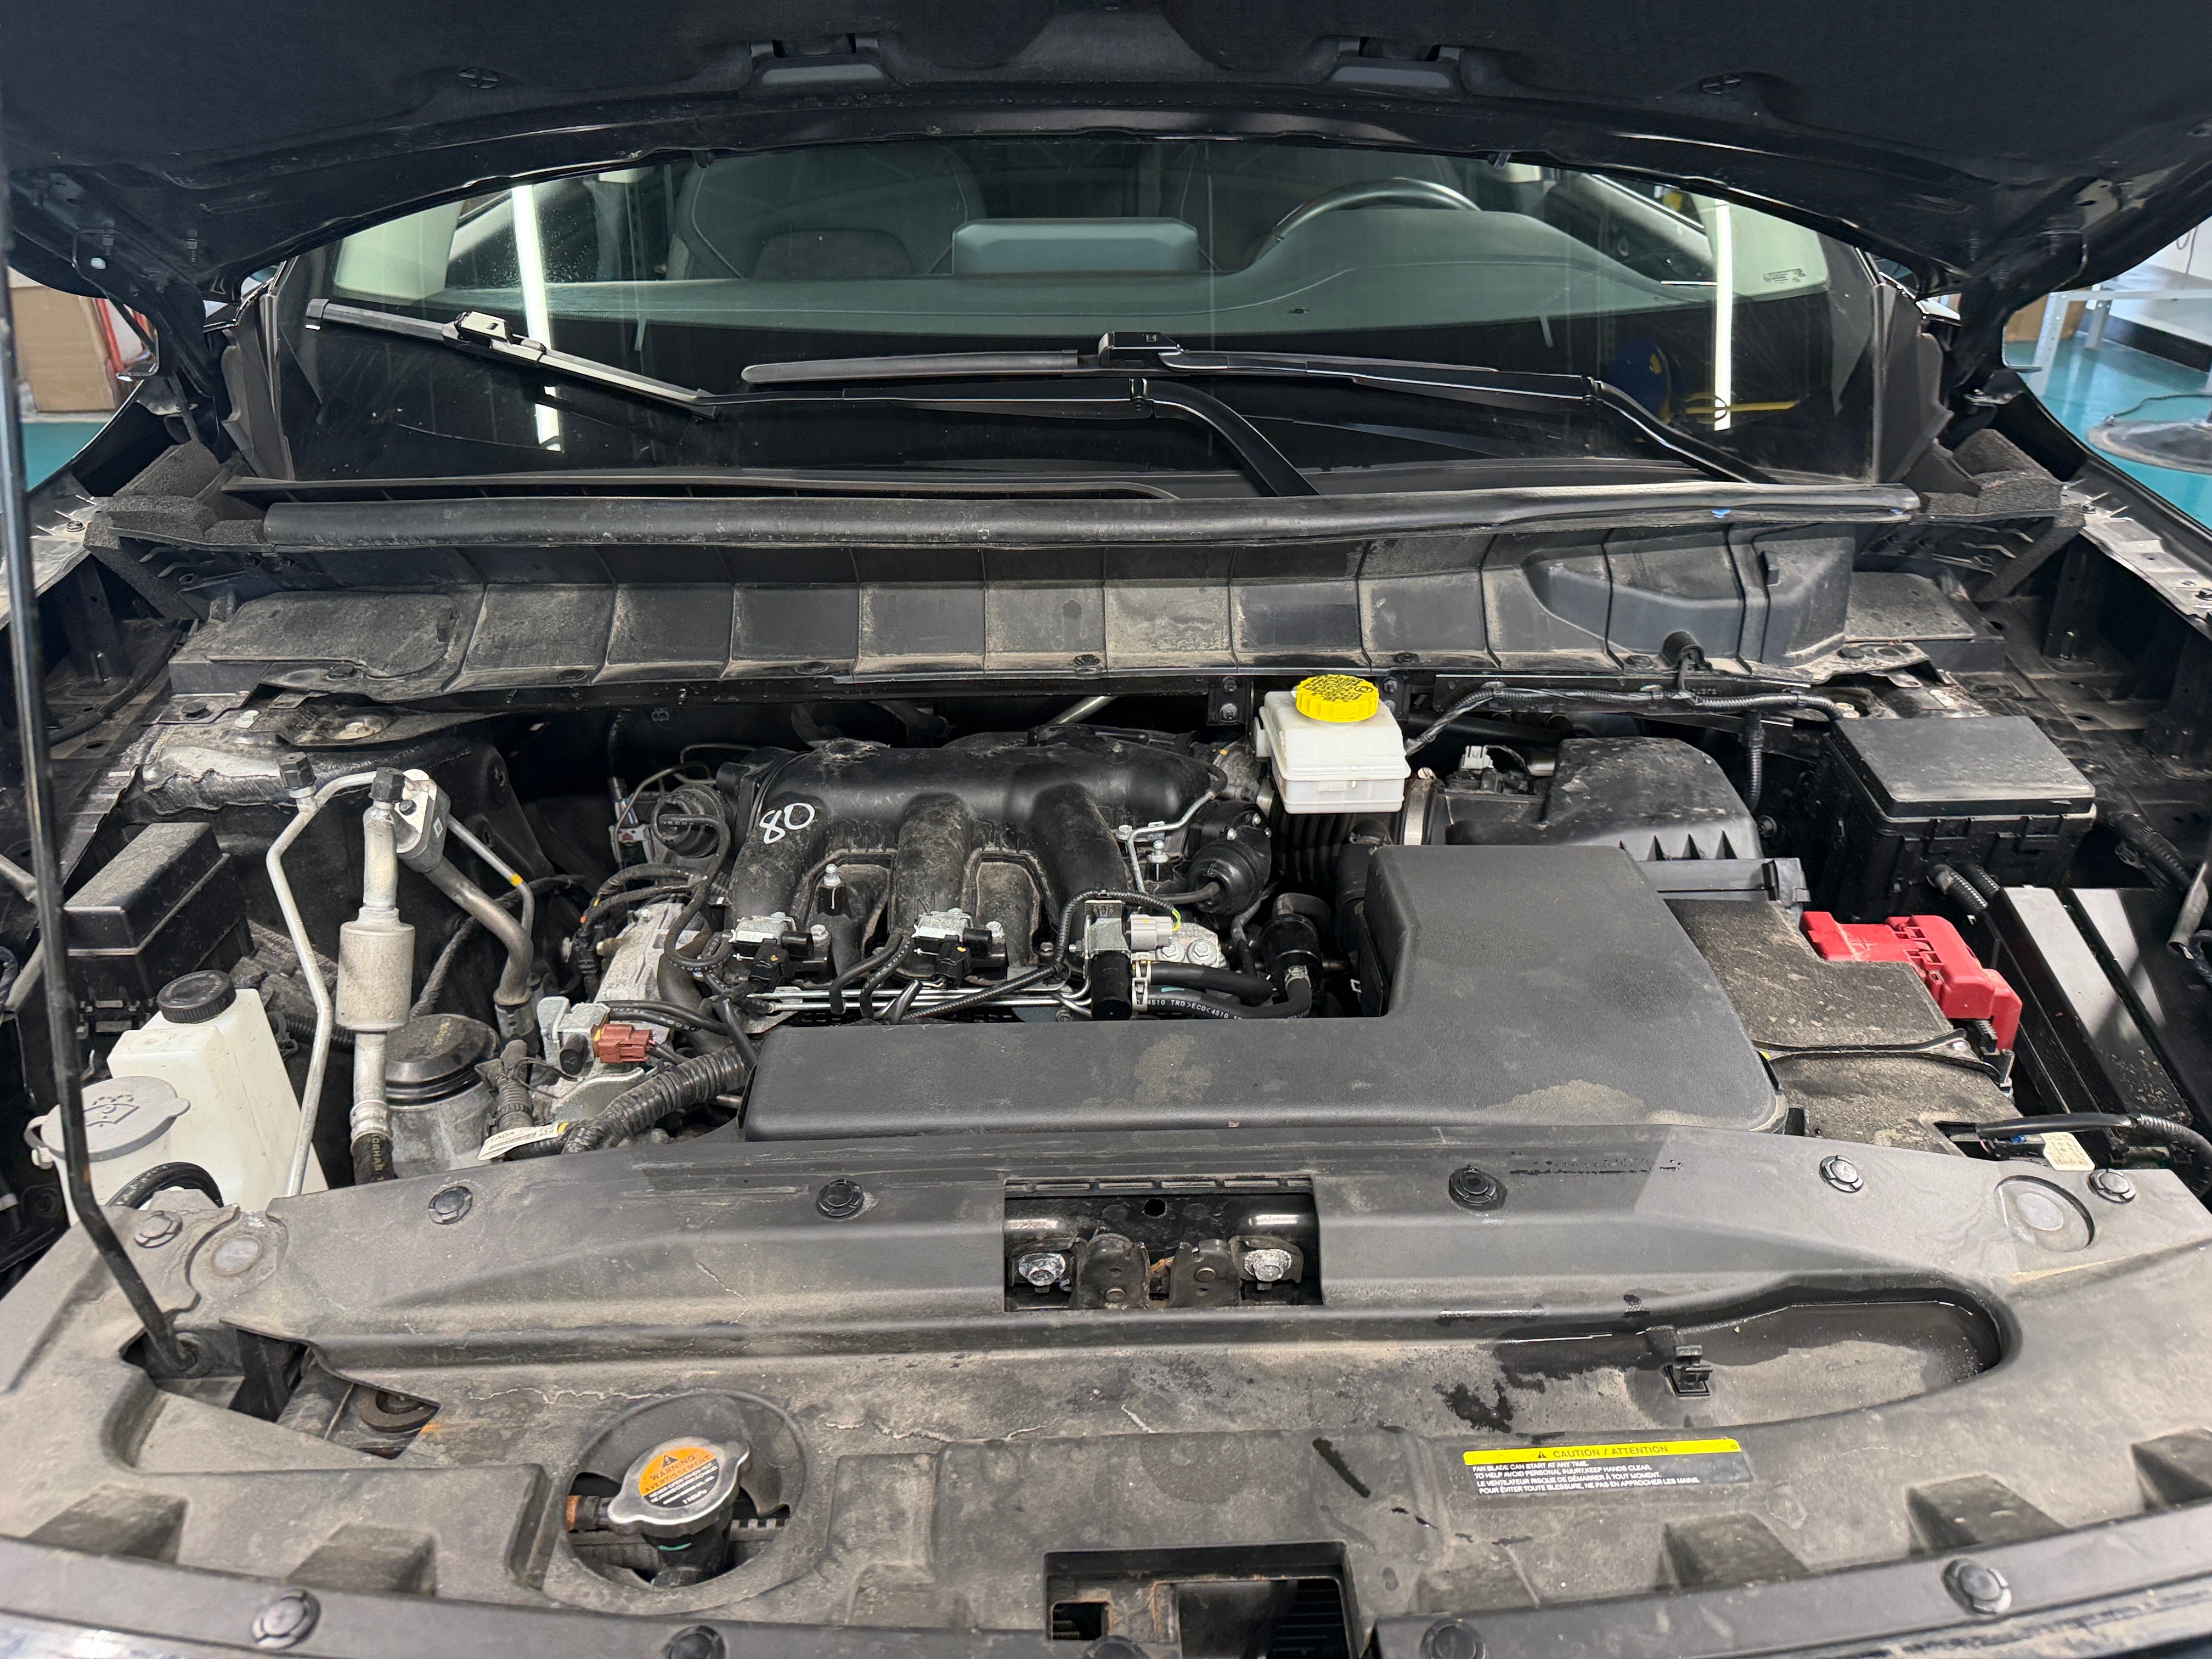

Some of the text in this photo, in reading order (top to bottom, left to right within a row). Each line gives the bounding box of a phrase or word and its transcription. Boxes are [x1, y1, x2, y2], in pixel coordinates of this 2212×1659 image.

[759, 803, 815, 844] 80
[1553, 1449, 1600, 1458] CAUTION
[1612, 1445, 1668, 1455] ATTENTION
[645, 1455, 709, 1492] AVERTISSEMENT
[650, 1454, 696, 1481] WARNING
[1525, 1469, 1561, 1477] PERSONAL
[1486, 1479, 1530, 1487] VENTILATEUR
[1568, 1474, 1605, 1482] DÉMARRER
[1500, 1485, 1523, 1493] ÉVITER
[1621, 1479, 1663, 1487] APPROCHER
